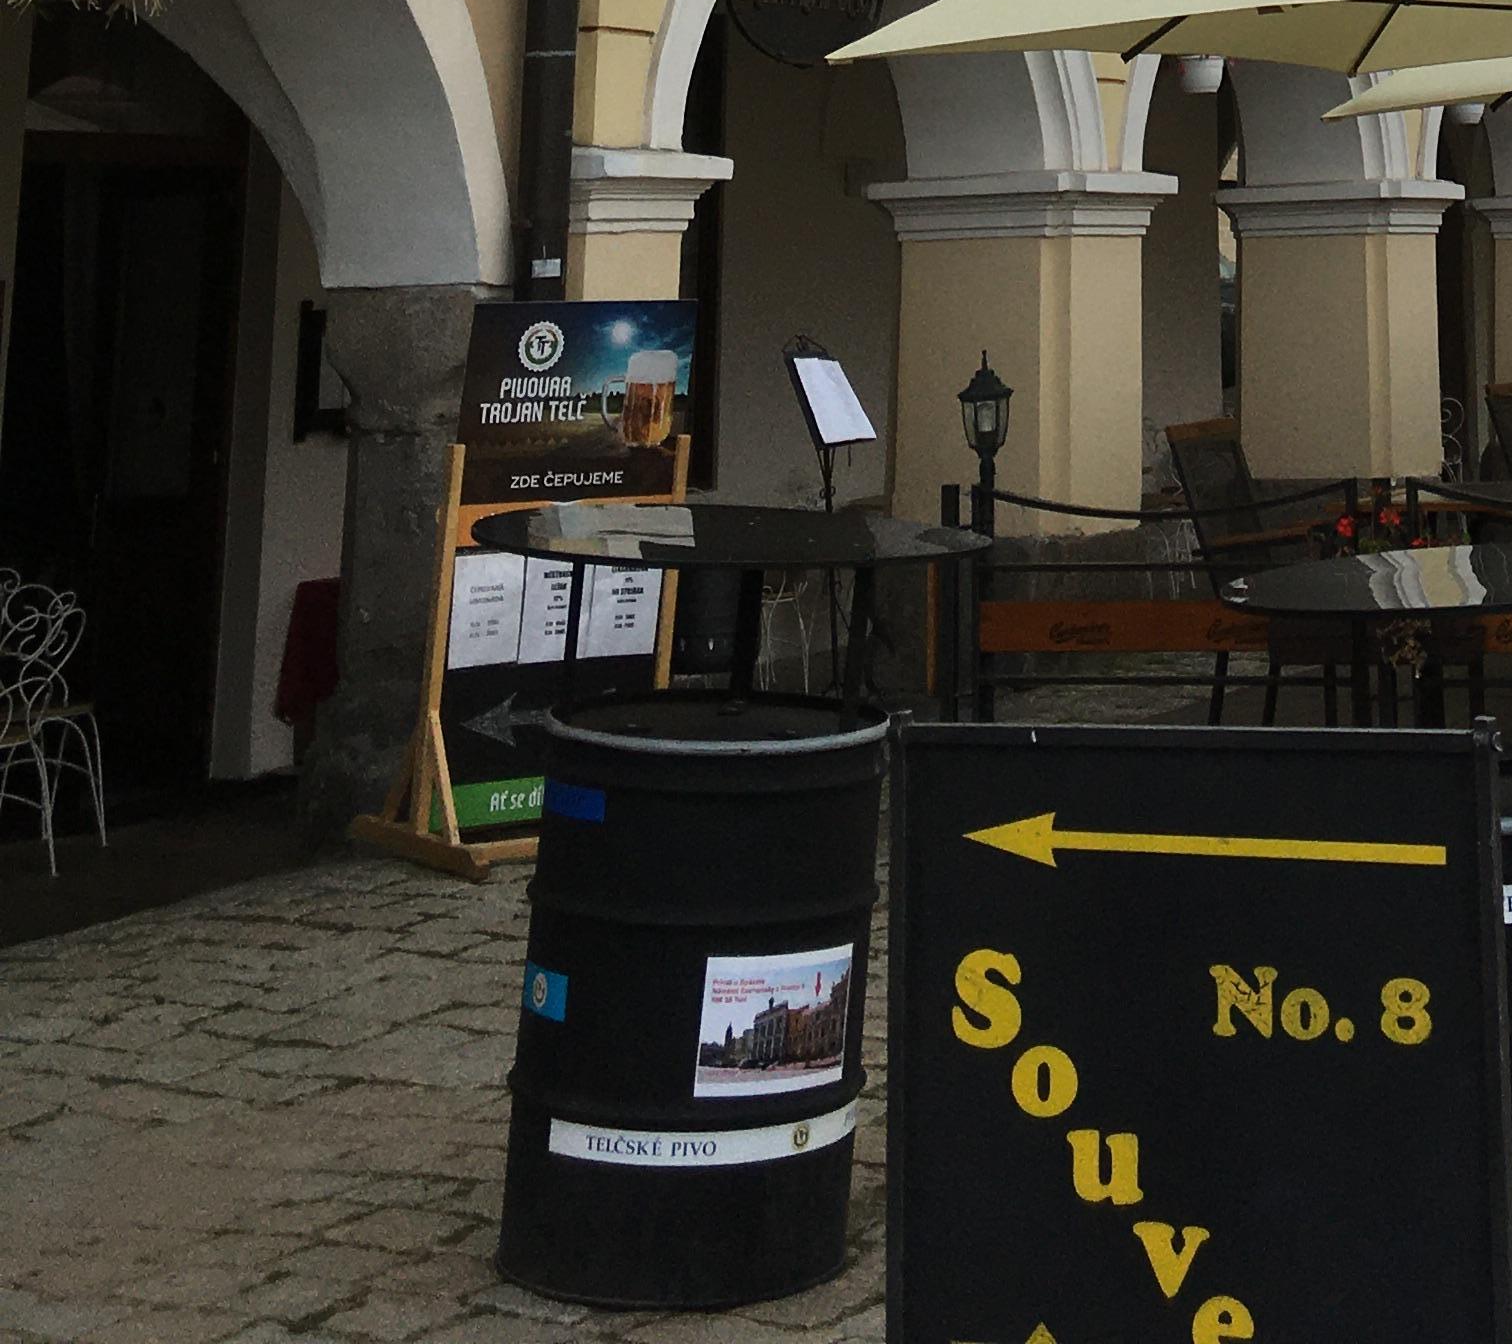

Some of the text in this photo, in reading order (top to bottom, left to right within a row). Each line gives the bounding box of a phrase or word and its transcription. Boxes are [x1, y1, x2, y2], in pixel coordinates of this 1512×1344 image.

[500, 375, 572, 399] PIVOVAR
[480, 393, 588, 424] TROJAN TELČ
[510, 471, 624, 489] ZDE ČEPUJEME
[510, 792, 526, 810] se
[1211, 965, 1431, 1044] No. 8
[585, 1134, 718, 1158] TELČSKÉ PIVO
